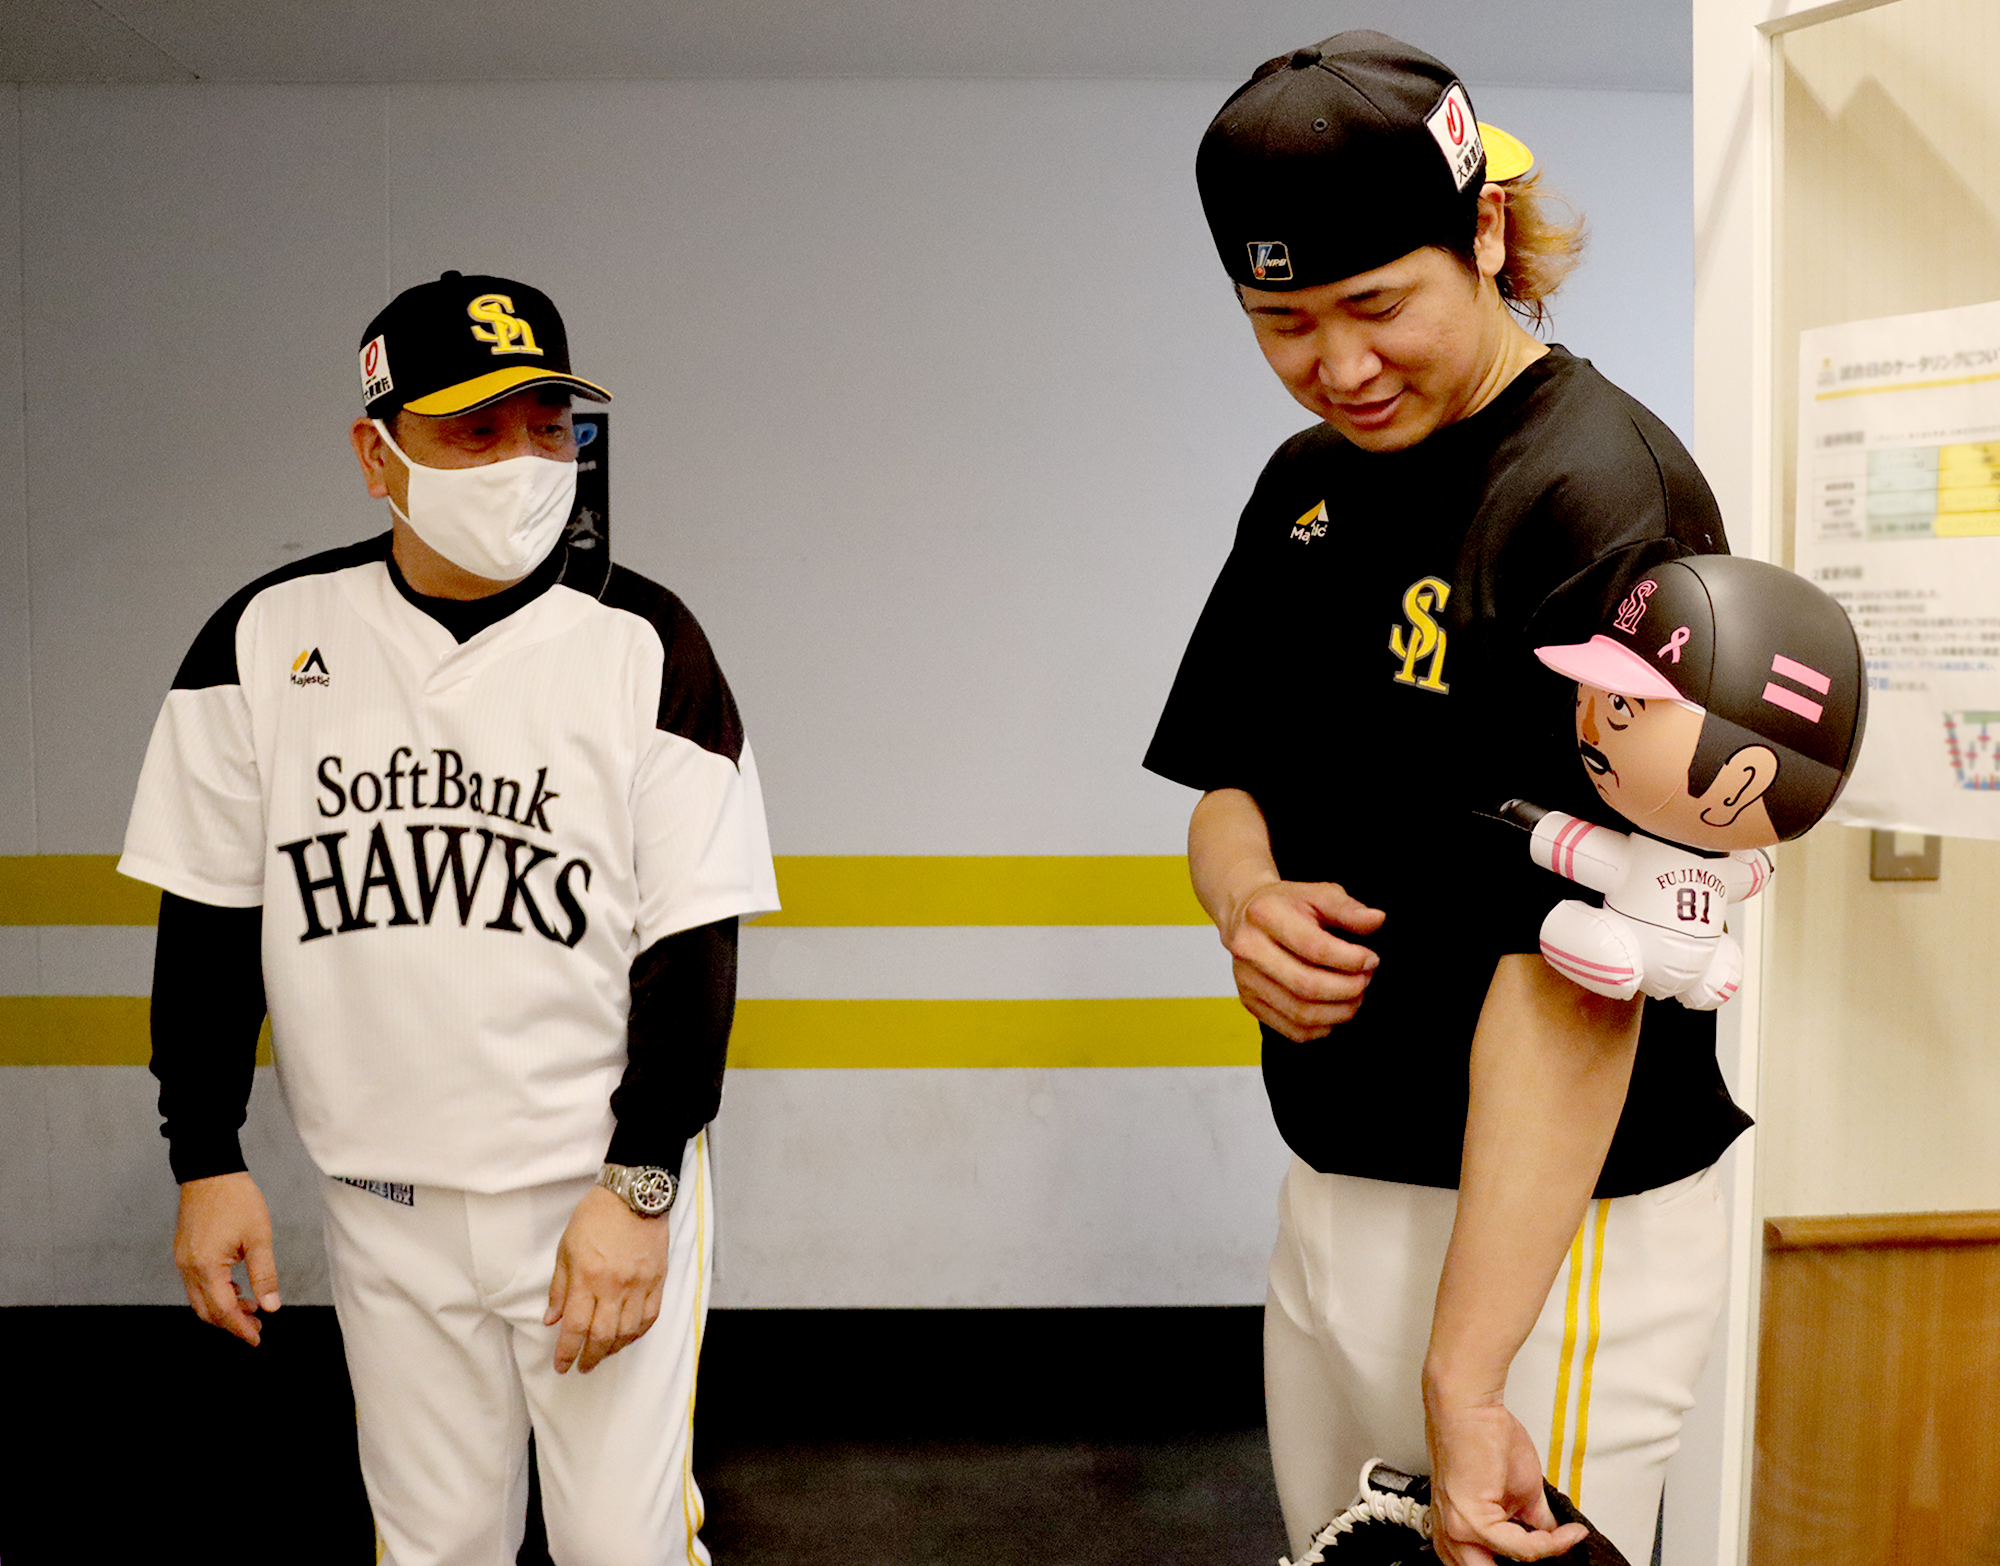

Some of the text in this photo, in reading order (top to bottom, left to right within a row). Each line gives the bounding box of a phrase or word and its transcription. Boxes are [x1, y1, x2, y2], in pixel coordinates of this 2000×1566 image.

[316, 746, 560, 834] SoftBank
[275, 819, 593, 949] HAWKS
[1656, 868, 1726, 898] FUJIMOTO
[1677, 888, 1711, 924] 81
